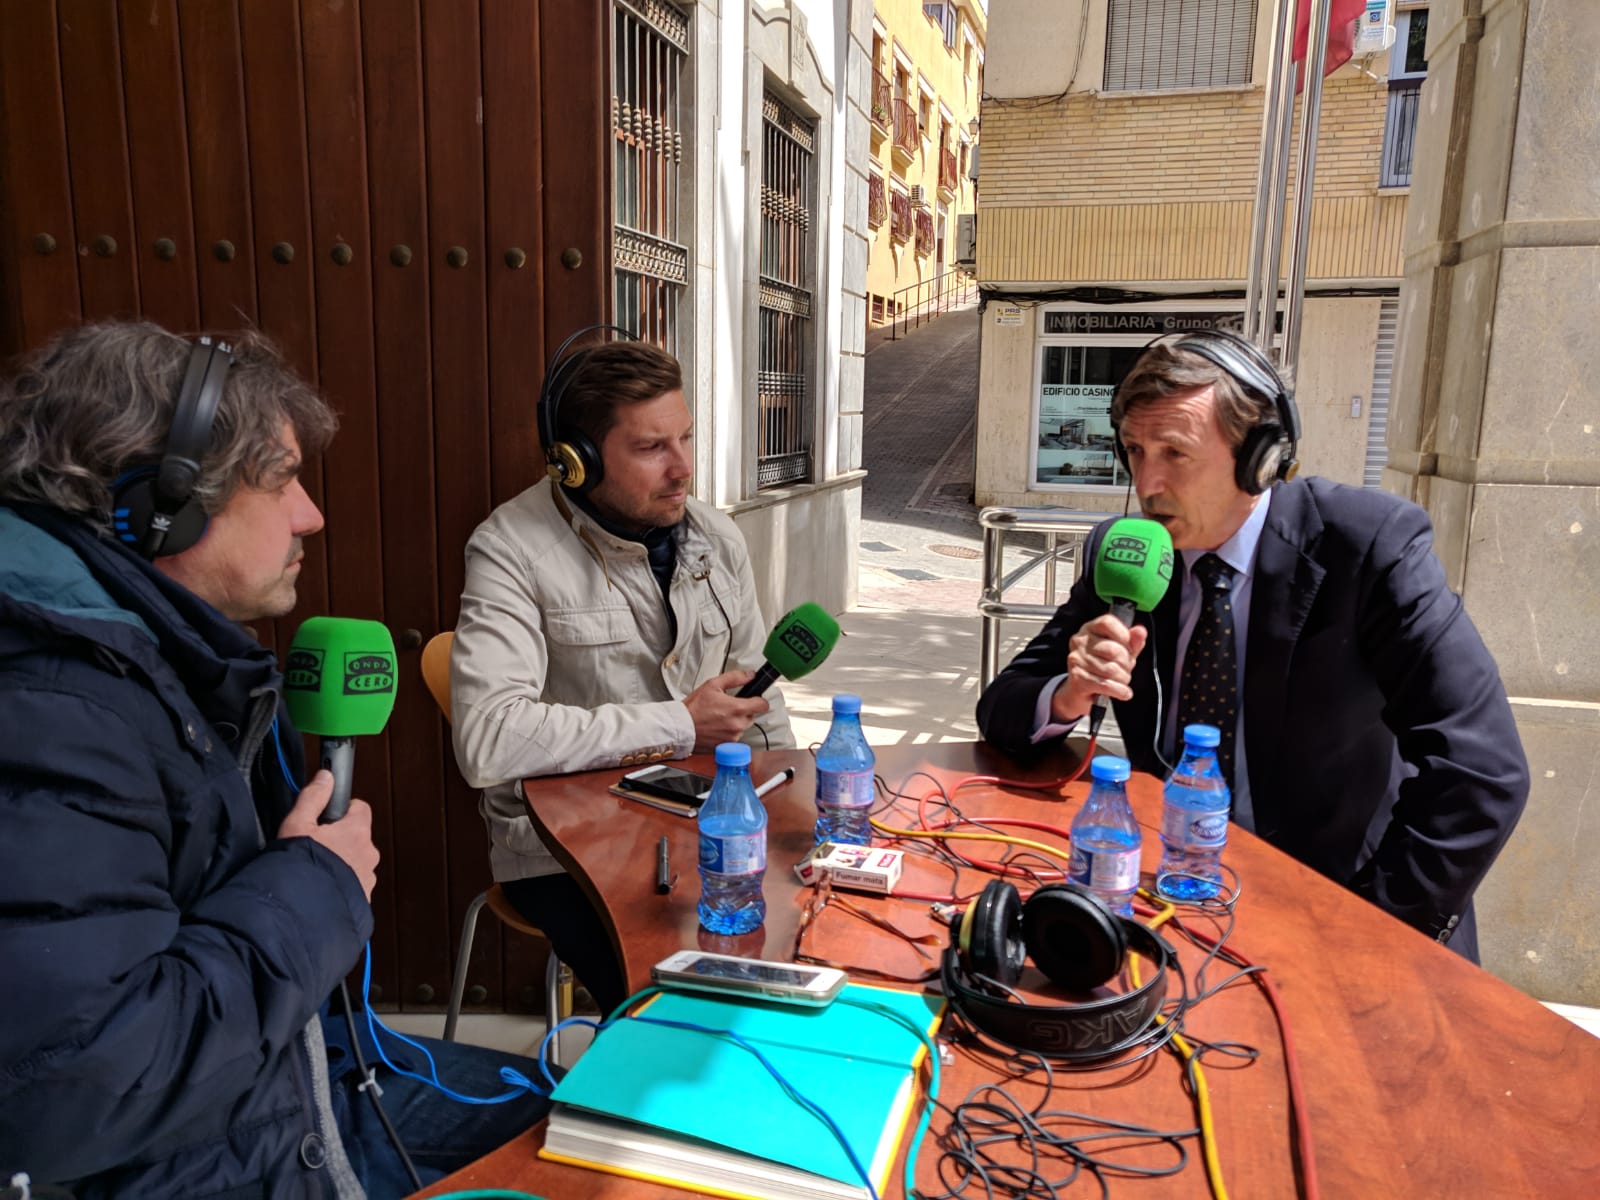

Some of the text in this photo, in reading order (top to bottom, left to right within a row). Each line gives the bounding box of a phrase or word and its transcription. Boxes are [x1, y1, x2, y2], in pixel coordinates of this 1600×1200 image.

[1051, 316, 1156, 329] INMOBILIARIA
[1043, 387, 1080, 396] EDIFICIO
[352, 661, 388, 669] ONDA
[354, 677, 388, 687] CERO
[836, 871, 884, 885] Fumar mata
[1028, 997, 1148, 1049] AKG
